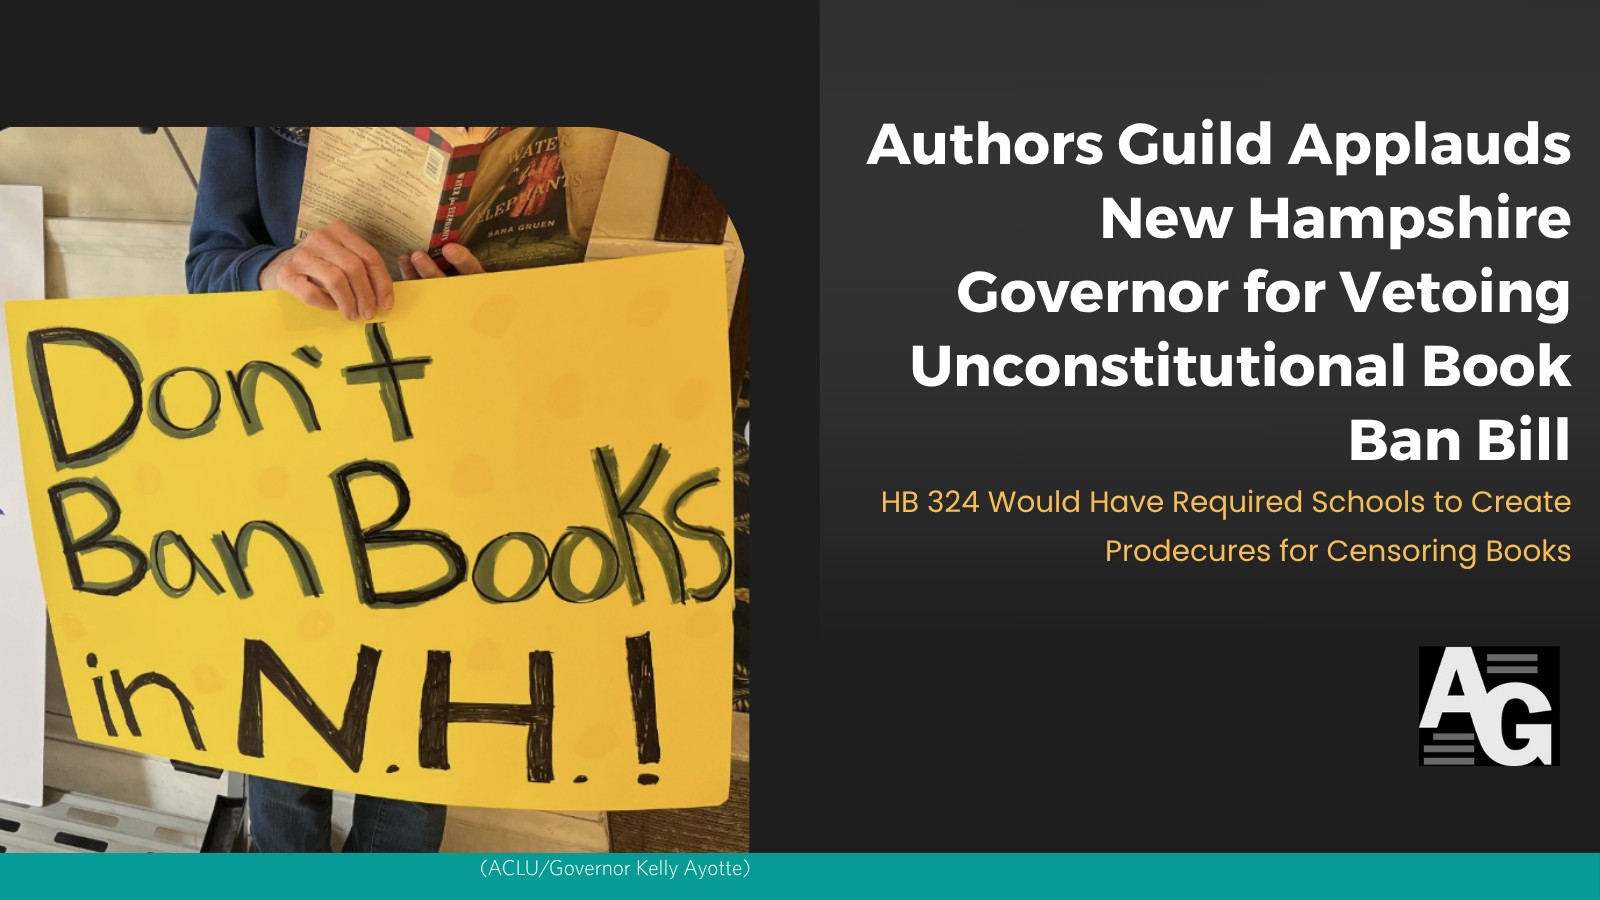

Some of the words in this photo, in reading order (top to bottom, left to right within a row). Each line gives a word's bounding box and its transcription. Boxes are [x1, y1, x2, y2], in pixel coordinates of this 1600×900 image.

[508, 134, 570, 164] WATER
[487, 226, 515, 238] SARA
[517, 219, 556, 231] GRUEN
[26, 321, 433, 472] Don't
[47, 476, 324, 599] Ban
[86, 652, 207, 751] in
